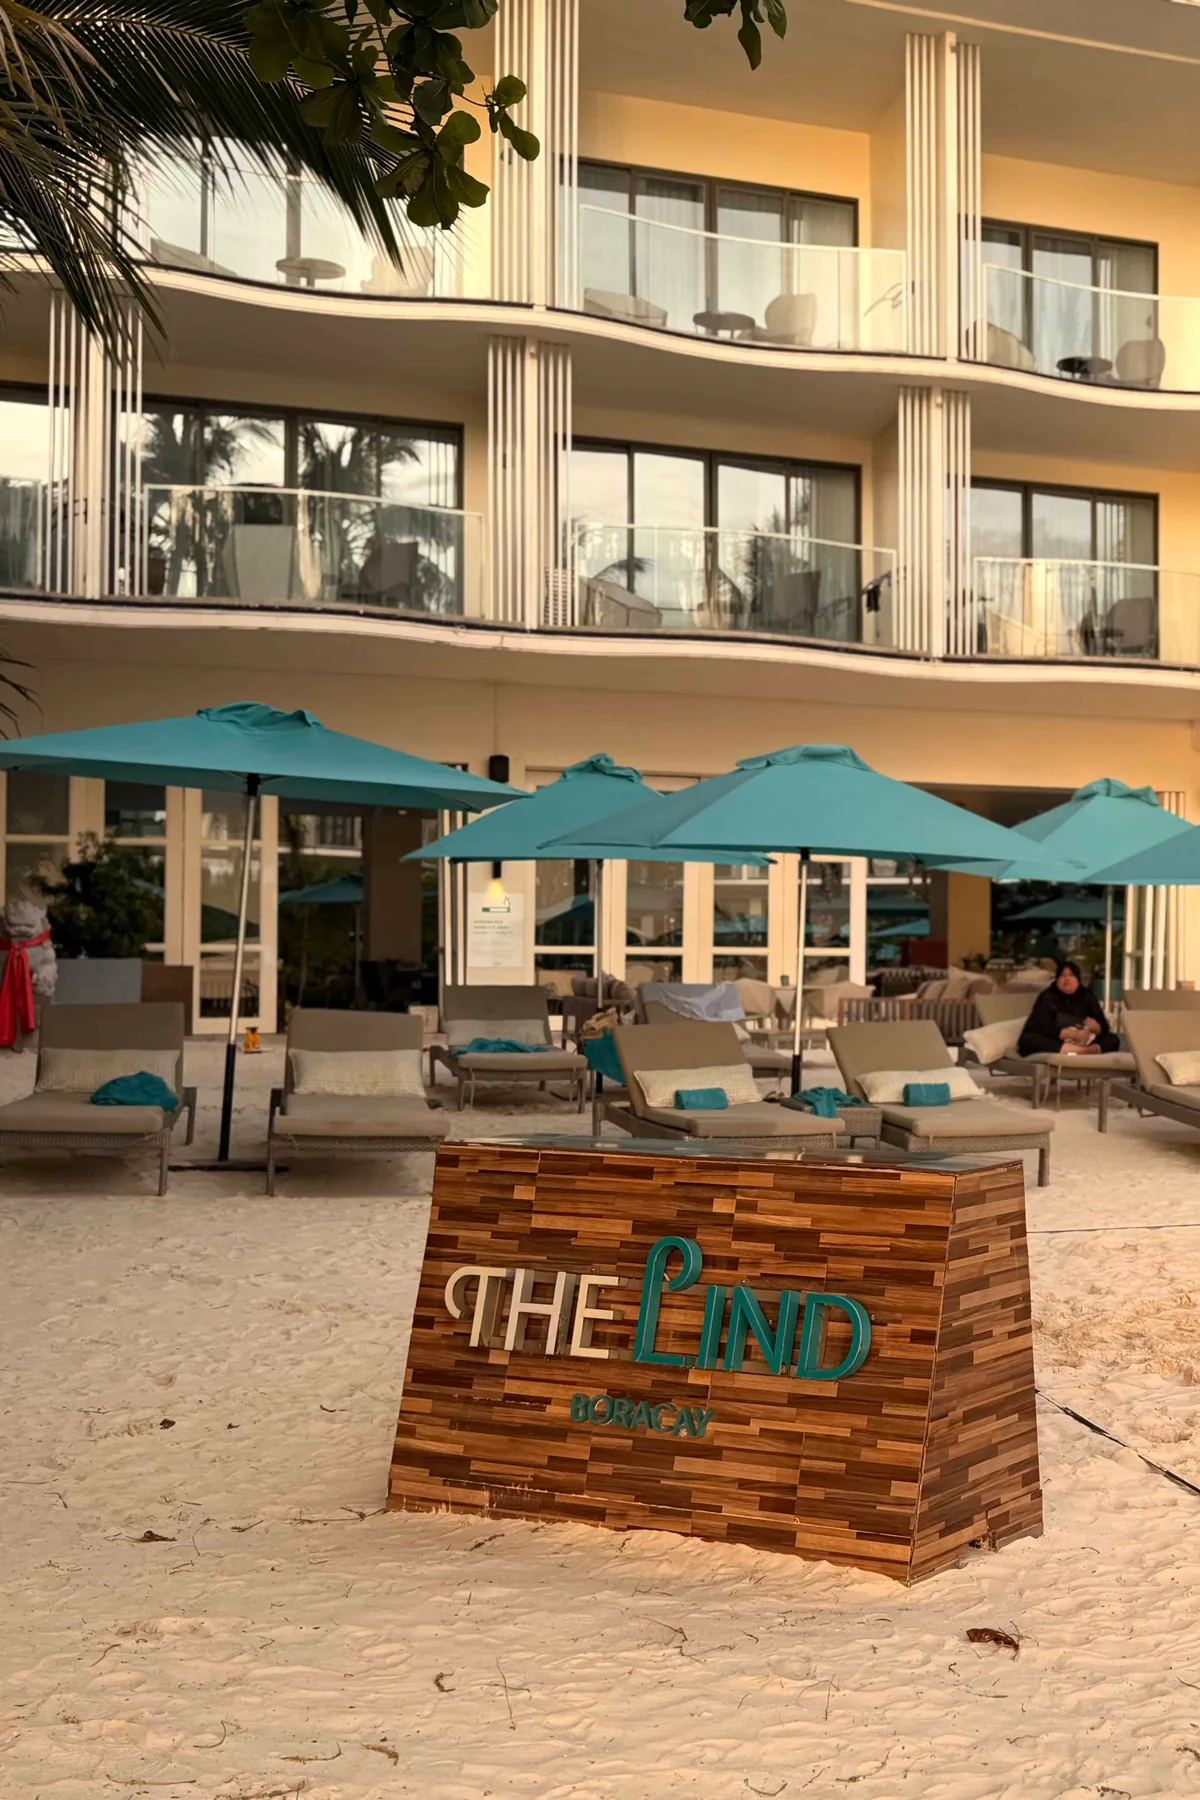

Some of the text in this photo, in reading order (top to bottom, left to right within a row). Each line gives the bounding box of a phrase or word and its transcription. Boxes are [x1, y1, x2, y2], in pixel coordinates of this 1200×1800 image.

[444, 1235, 872, 1380] THE LIND
[568, 1392, 715, 1438] BORACAY
